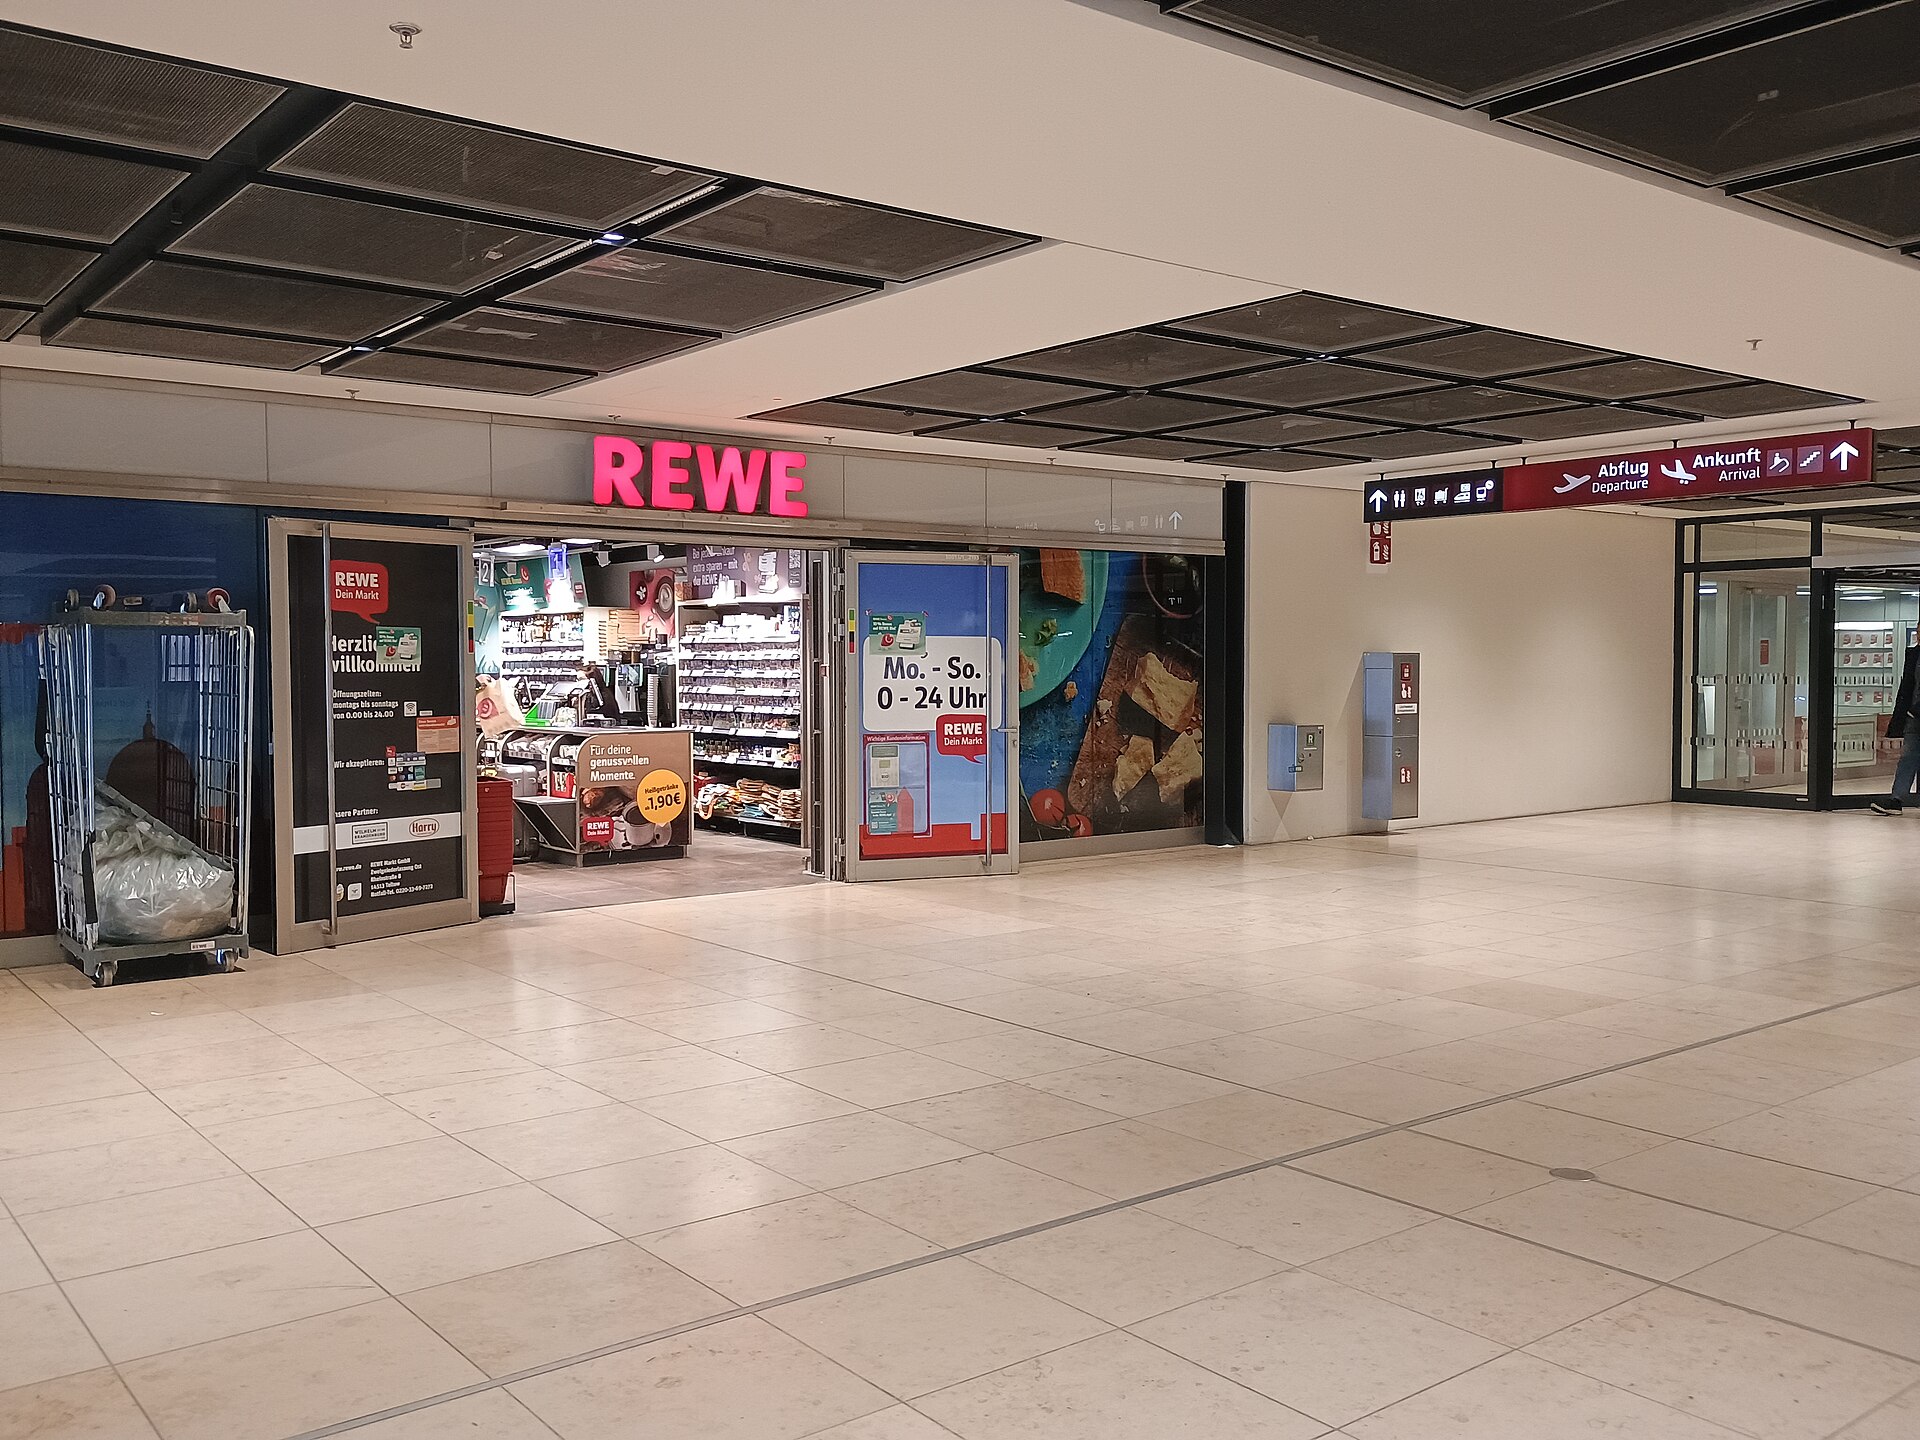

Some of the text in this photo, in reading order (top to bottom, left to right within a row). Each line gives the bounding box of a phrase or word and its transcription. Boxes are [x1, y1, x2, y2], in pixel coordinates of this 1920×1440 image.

[1692, 448, 1762, 469] Ankunft
[1598, 461, 1649, 478] Abflug
[1718, 465, 1761, 482] Arrival
[593, 435, 808, 518] REWE
[1592, 478, 1649, 494] Departure
[481, 562, 489, 583] 2
[335, 571, 379, 588] REWE
[701, 573, 718, 585] REWE
[335, 588, 380, 600] Dein Markt
[883, 657, 926, 679] Mo.
[947, 656, 981, 679] So.
[877, 686, 893, 710] 0
[915, 686, 943, 709] 24
[949, 686, 987, 709] Uhr
[360, 700, 371, 708] bis
[371, 700, 399, 709] sonntags
[345, 711, 363, 719] 0.00
[363, 710, 373, 719] bis
[373, 710, 394, 718] 24.00
[944, 722, 983, 735] REWE
[944, 736, 983, 746] Dein Markt
[1307, 734, 1315, 745] R
[590, 744, 632, 756] Für deine
[345, 758, 385, 769] akzeptieren:
[590, 755, 650, 770] genussvollen
[590, 770, 636, 782] Momente.
[644, 783, 679, 795] Heißgetränke
[647, 792, 682, 811] 1,90€
[352, 808, 379, 817] Partner:
[412, 822, 437, 833] Harry
[587, 821, 610, 830] REWE
